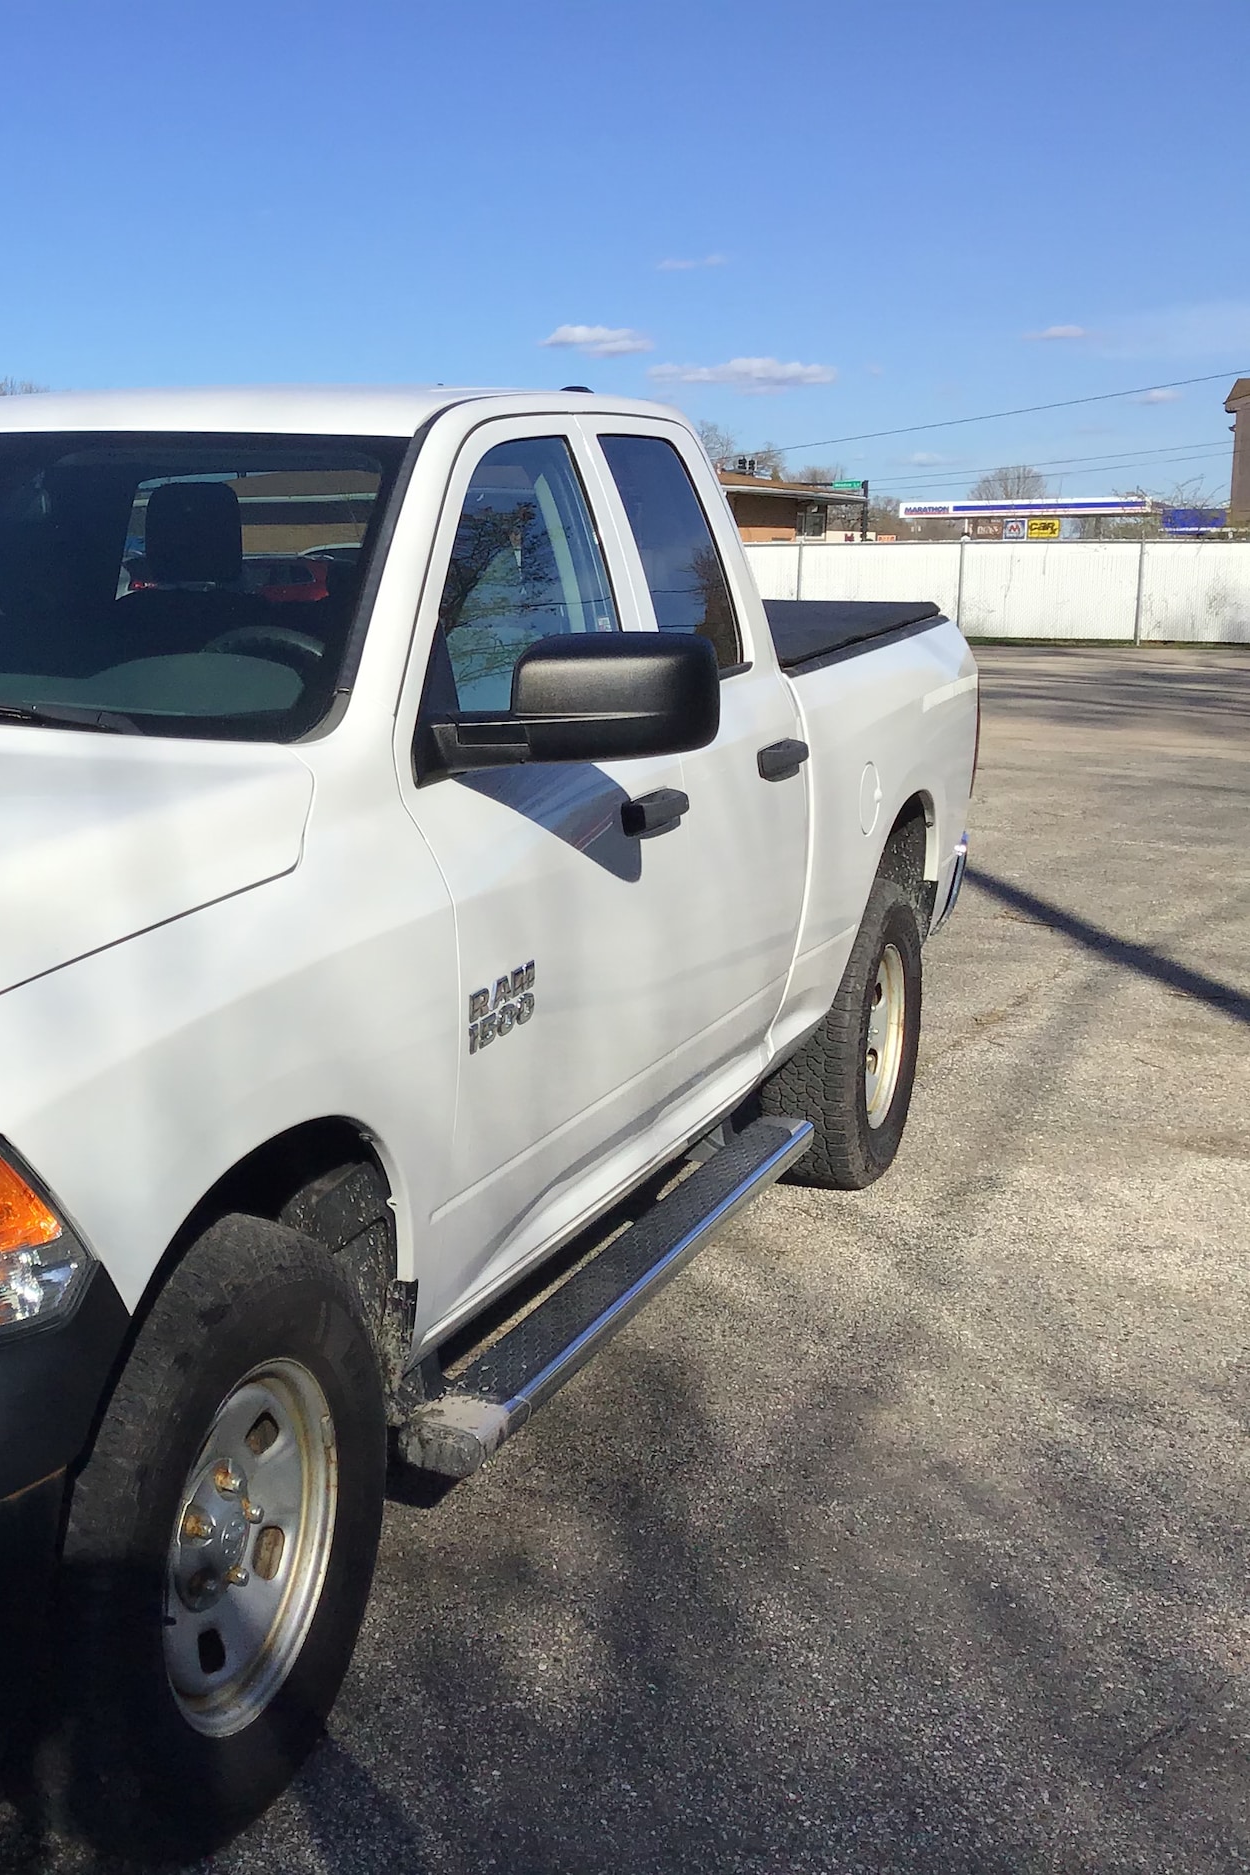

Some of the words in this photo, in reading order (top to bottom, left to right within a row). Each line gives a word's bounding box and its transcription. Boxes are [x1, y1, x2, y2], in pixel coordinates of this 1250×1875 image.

[904, 506, 950, 514] MARATHON
[469, 959, 535, 1024] RAM
[468, 992, 534, 1056] 1500
